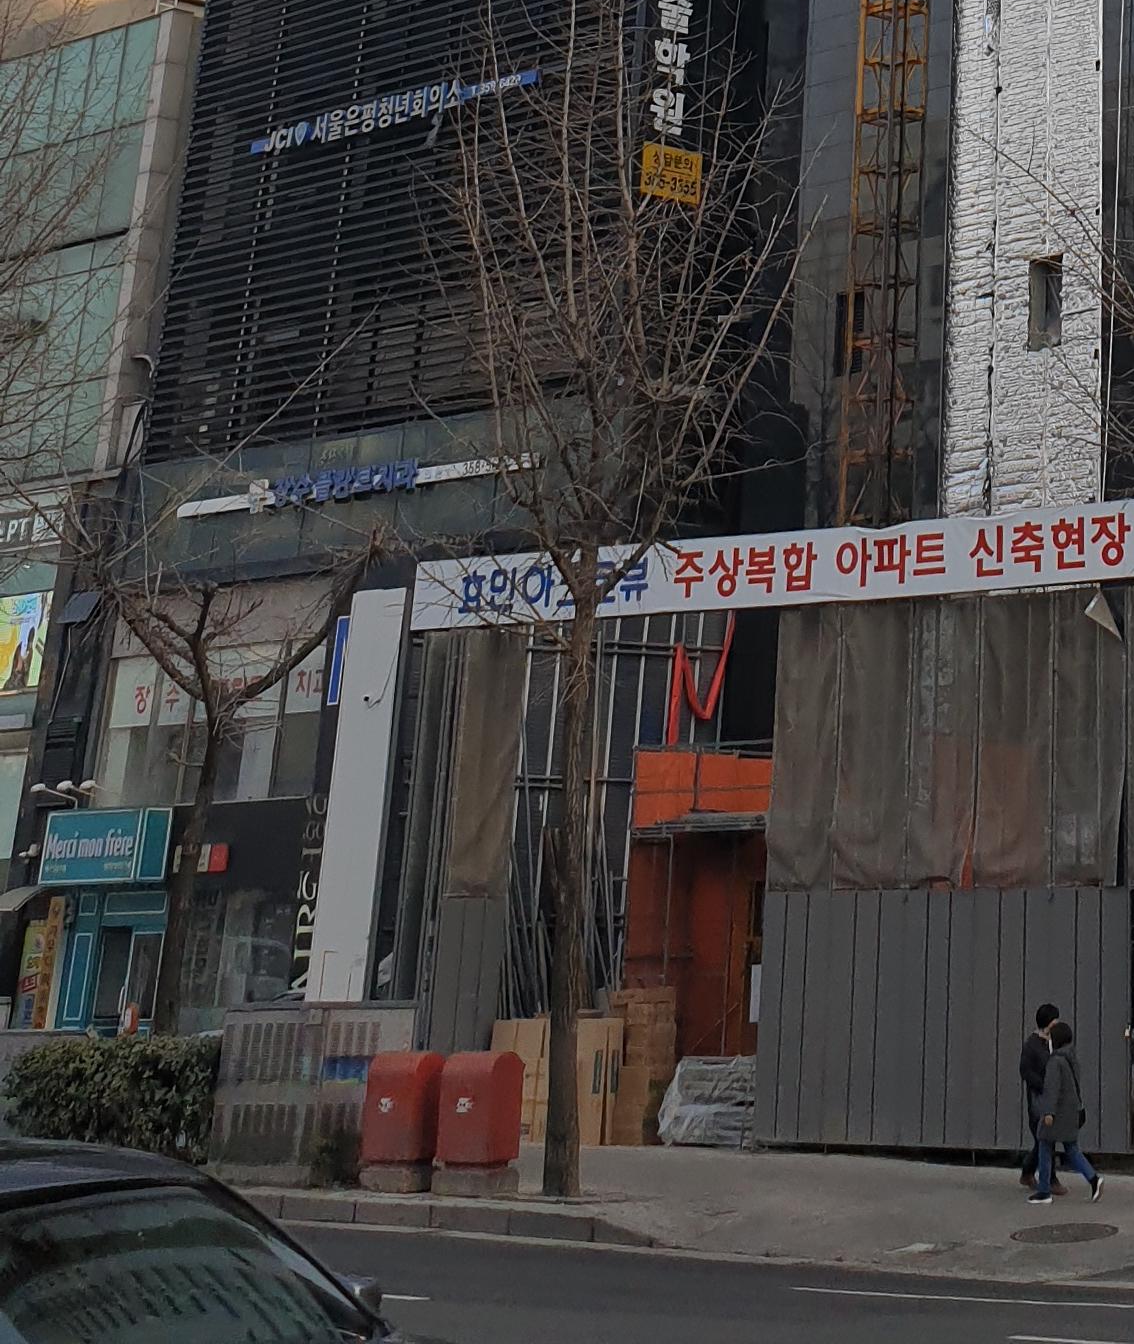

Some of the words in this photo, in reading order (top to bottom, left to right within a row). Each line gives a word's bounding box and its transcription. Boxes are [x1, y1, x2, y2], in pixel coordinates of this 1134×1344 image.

[264, 126, 295, 153] JCI
[673, 541, 818, 600] 주상복합
[835, 531, 947, 589] 아파트
[968, 511, 1132, 579] 신축현장
[78, 837, 103, 859] mon
